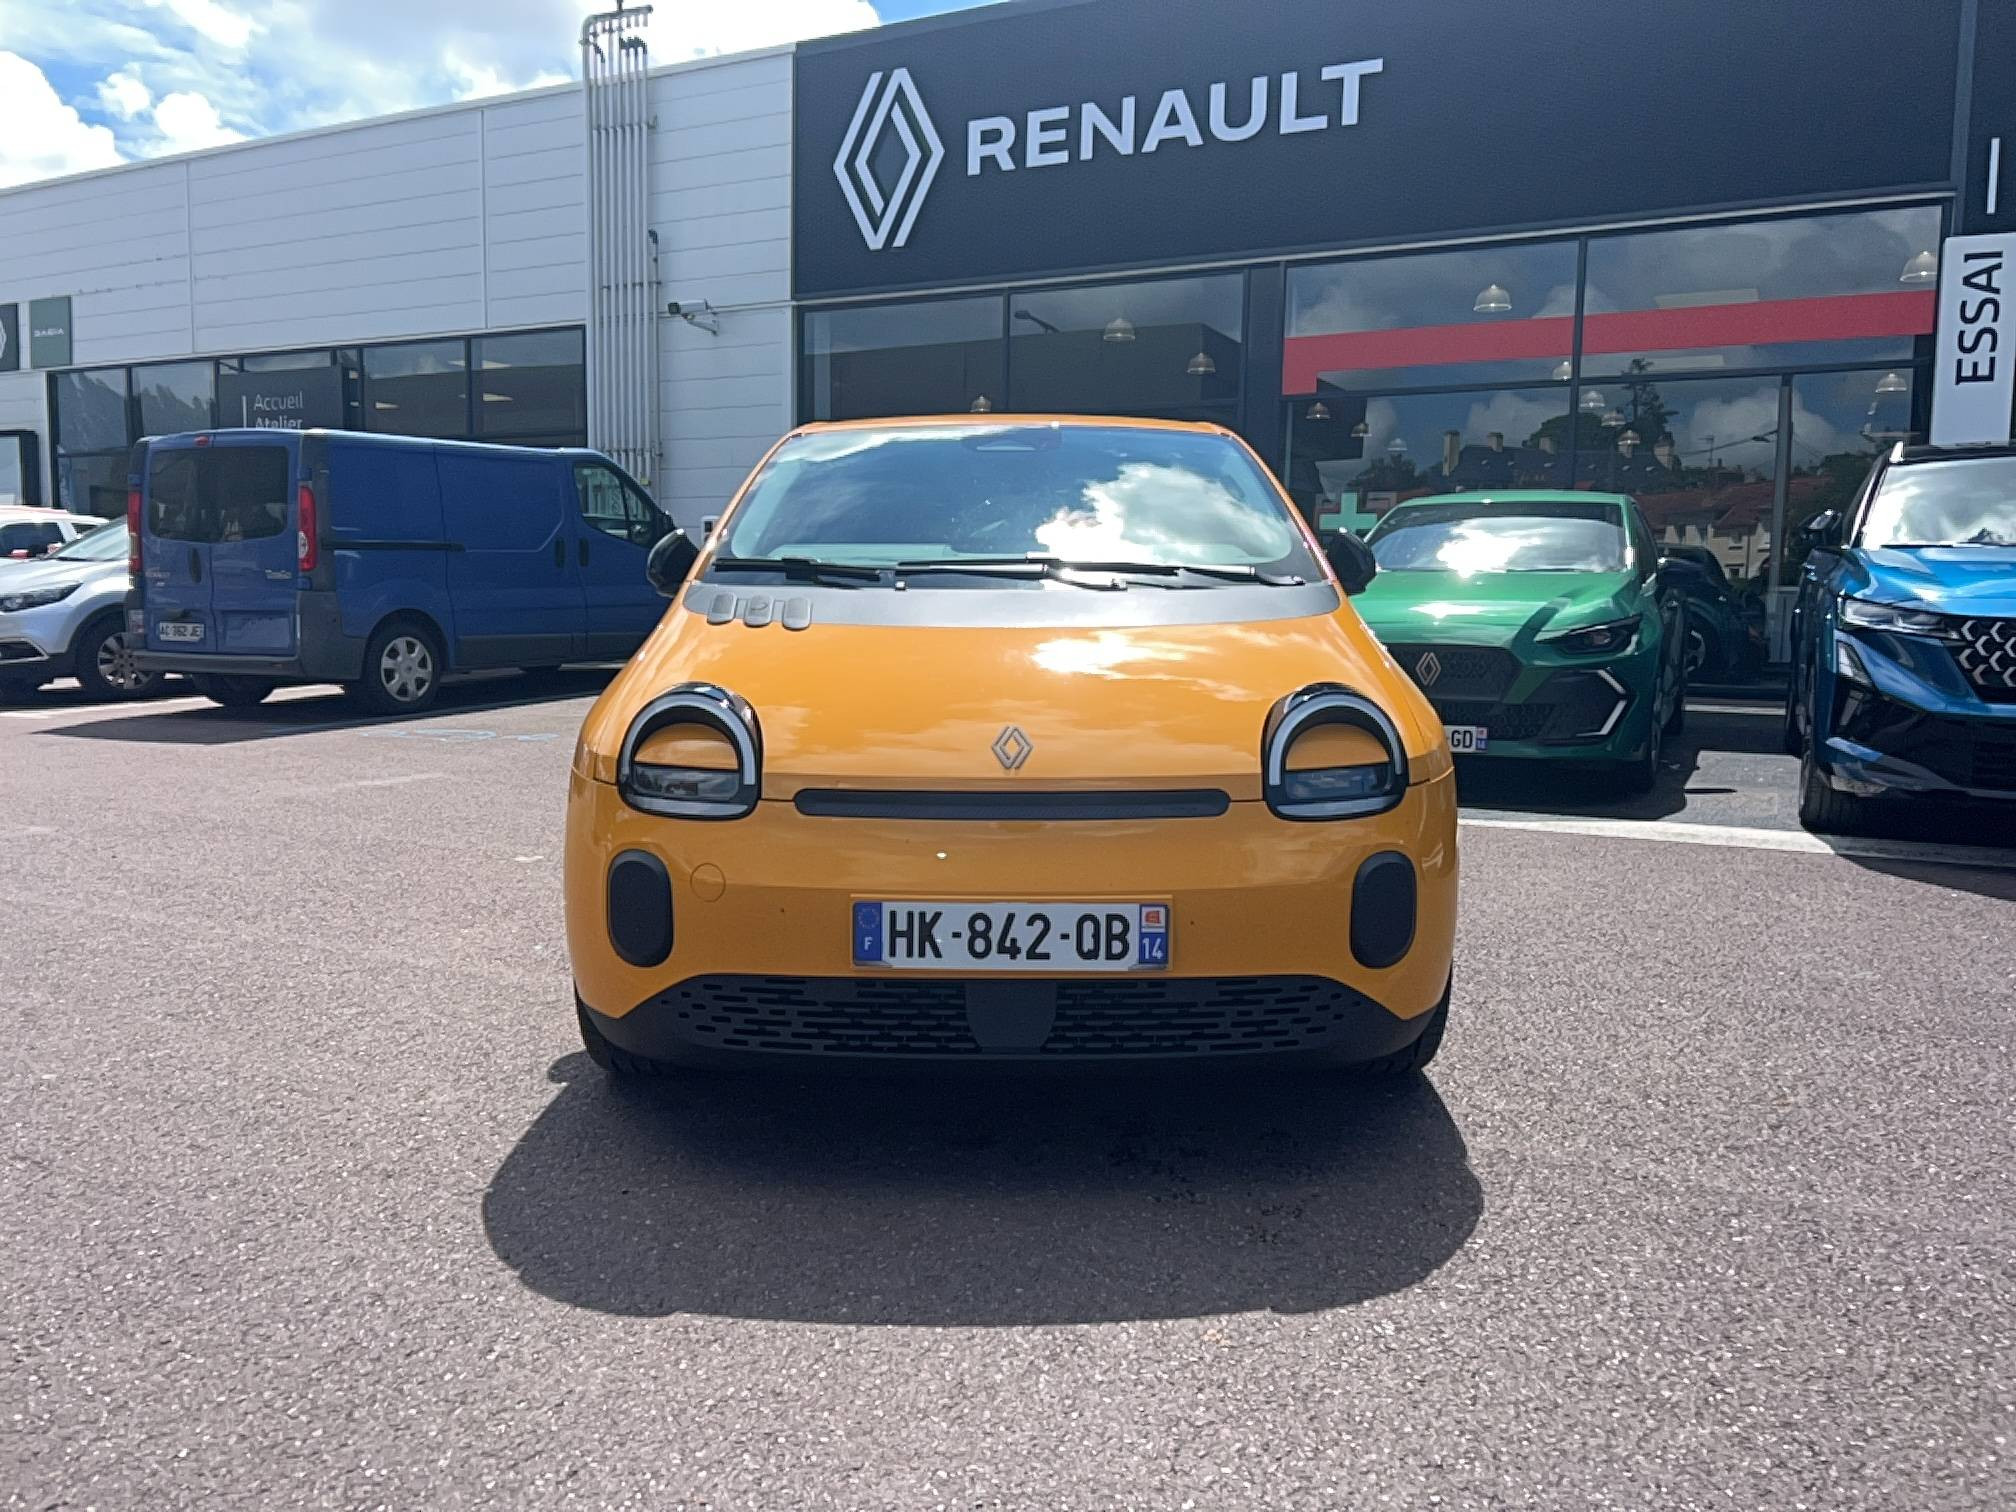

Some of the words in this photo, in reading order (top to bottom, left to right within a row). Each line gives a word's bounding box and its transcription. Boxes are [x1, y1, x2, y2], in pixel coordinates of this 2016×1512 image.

[967, 58, 1383, 176] RENAULT
[1955, 250, 2003, 386] ESSAI
[254, 391, 303, 411] Accueil
[255, 415, 303, 429] Atelier
[864, 937, 873, 950] F
[889, 910, 1130, 960] HK-842-QB
[1143, 937, 1163, 960] 14
